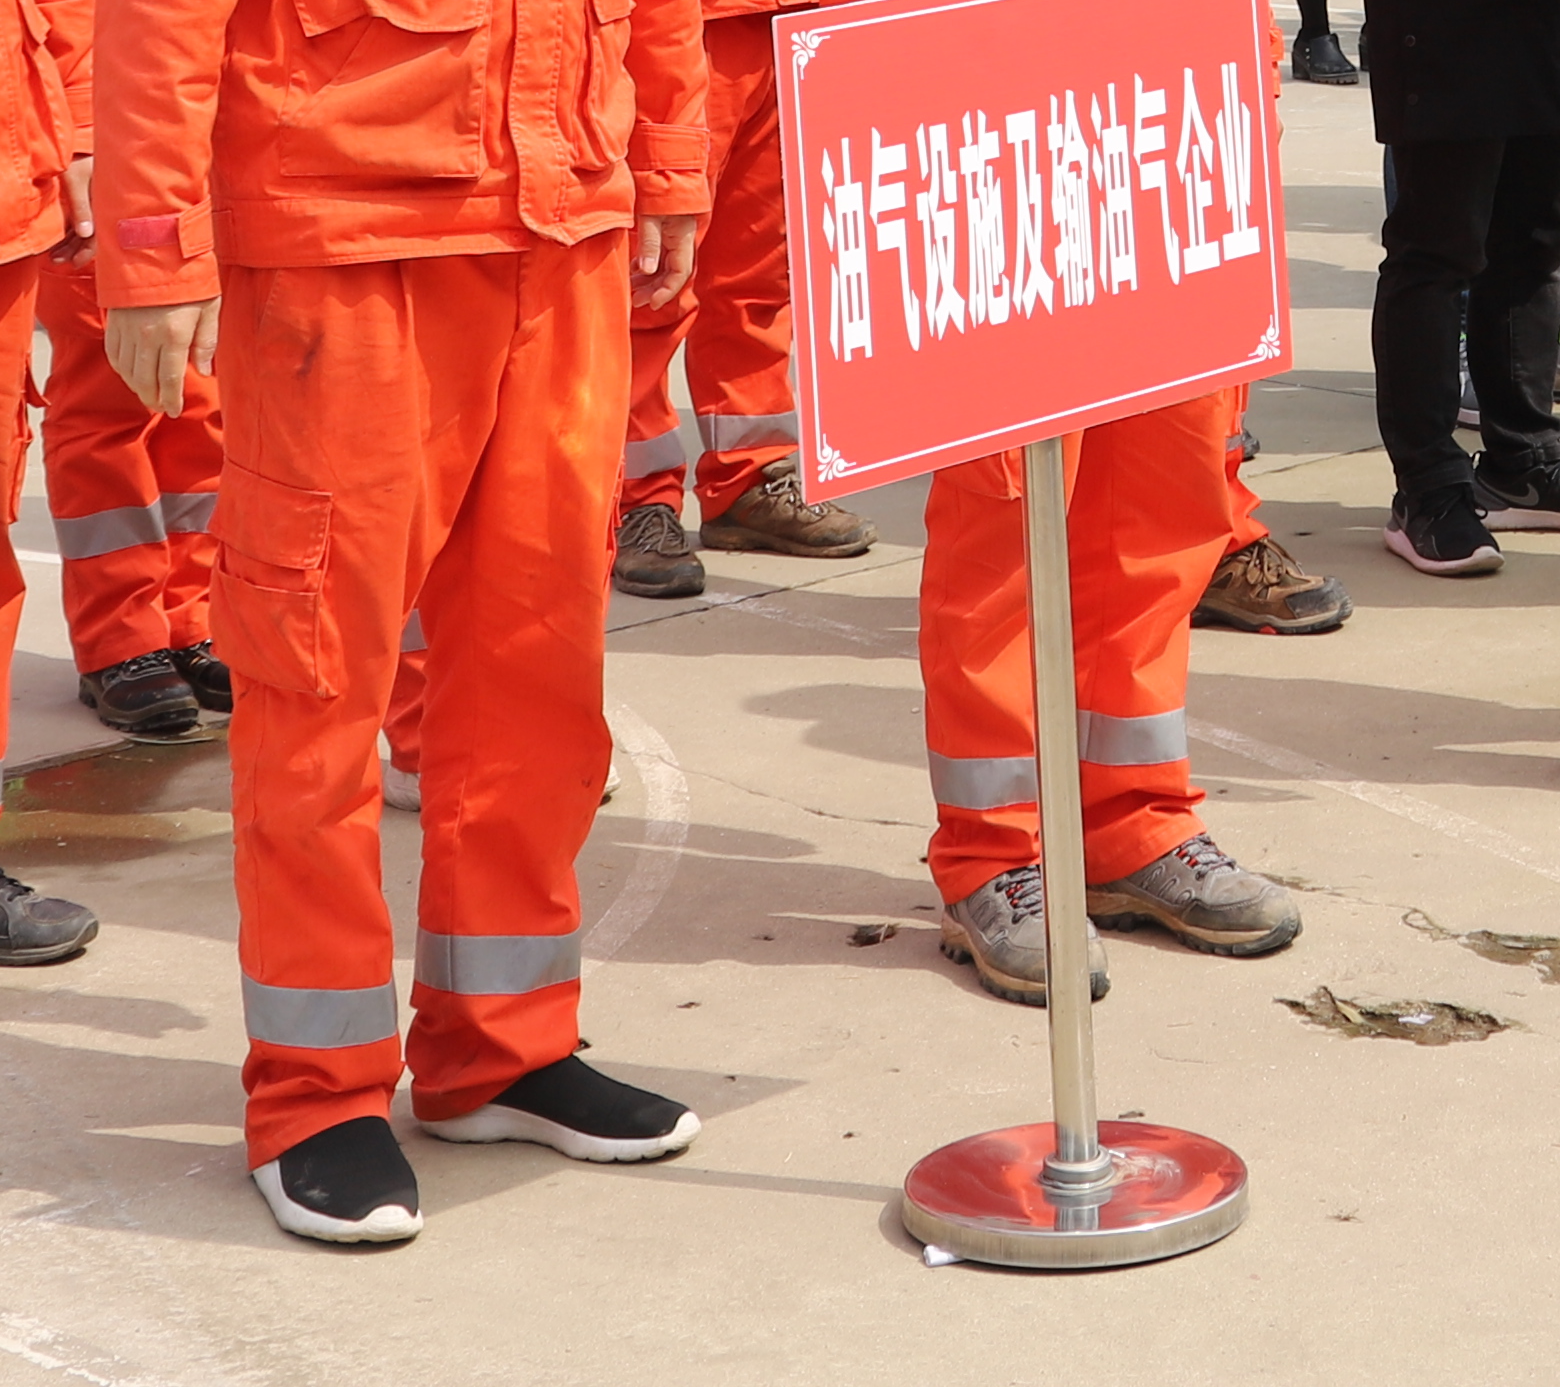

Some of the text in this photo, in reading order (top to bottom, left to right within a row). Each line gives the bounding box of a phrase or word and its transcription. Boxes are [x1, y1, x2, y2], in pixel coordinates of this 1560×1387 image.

[821, 62, 1261, 363] 油气设施及输油气企业
